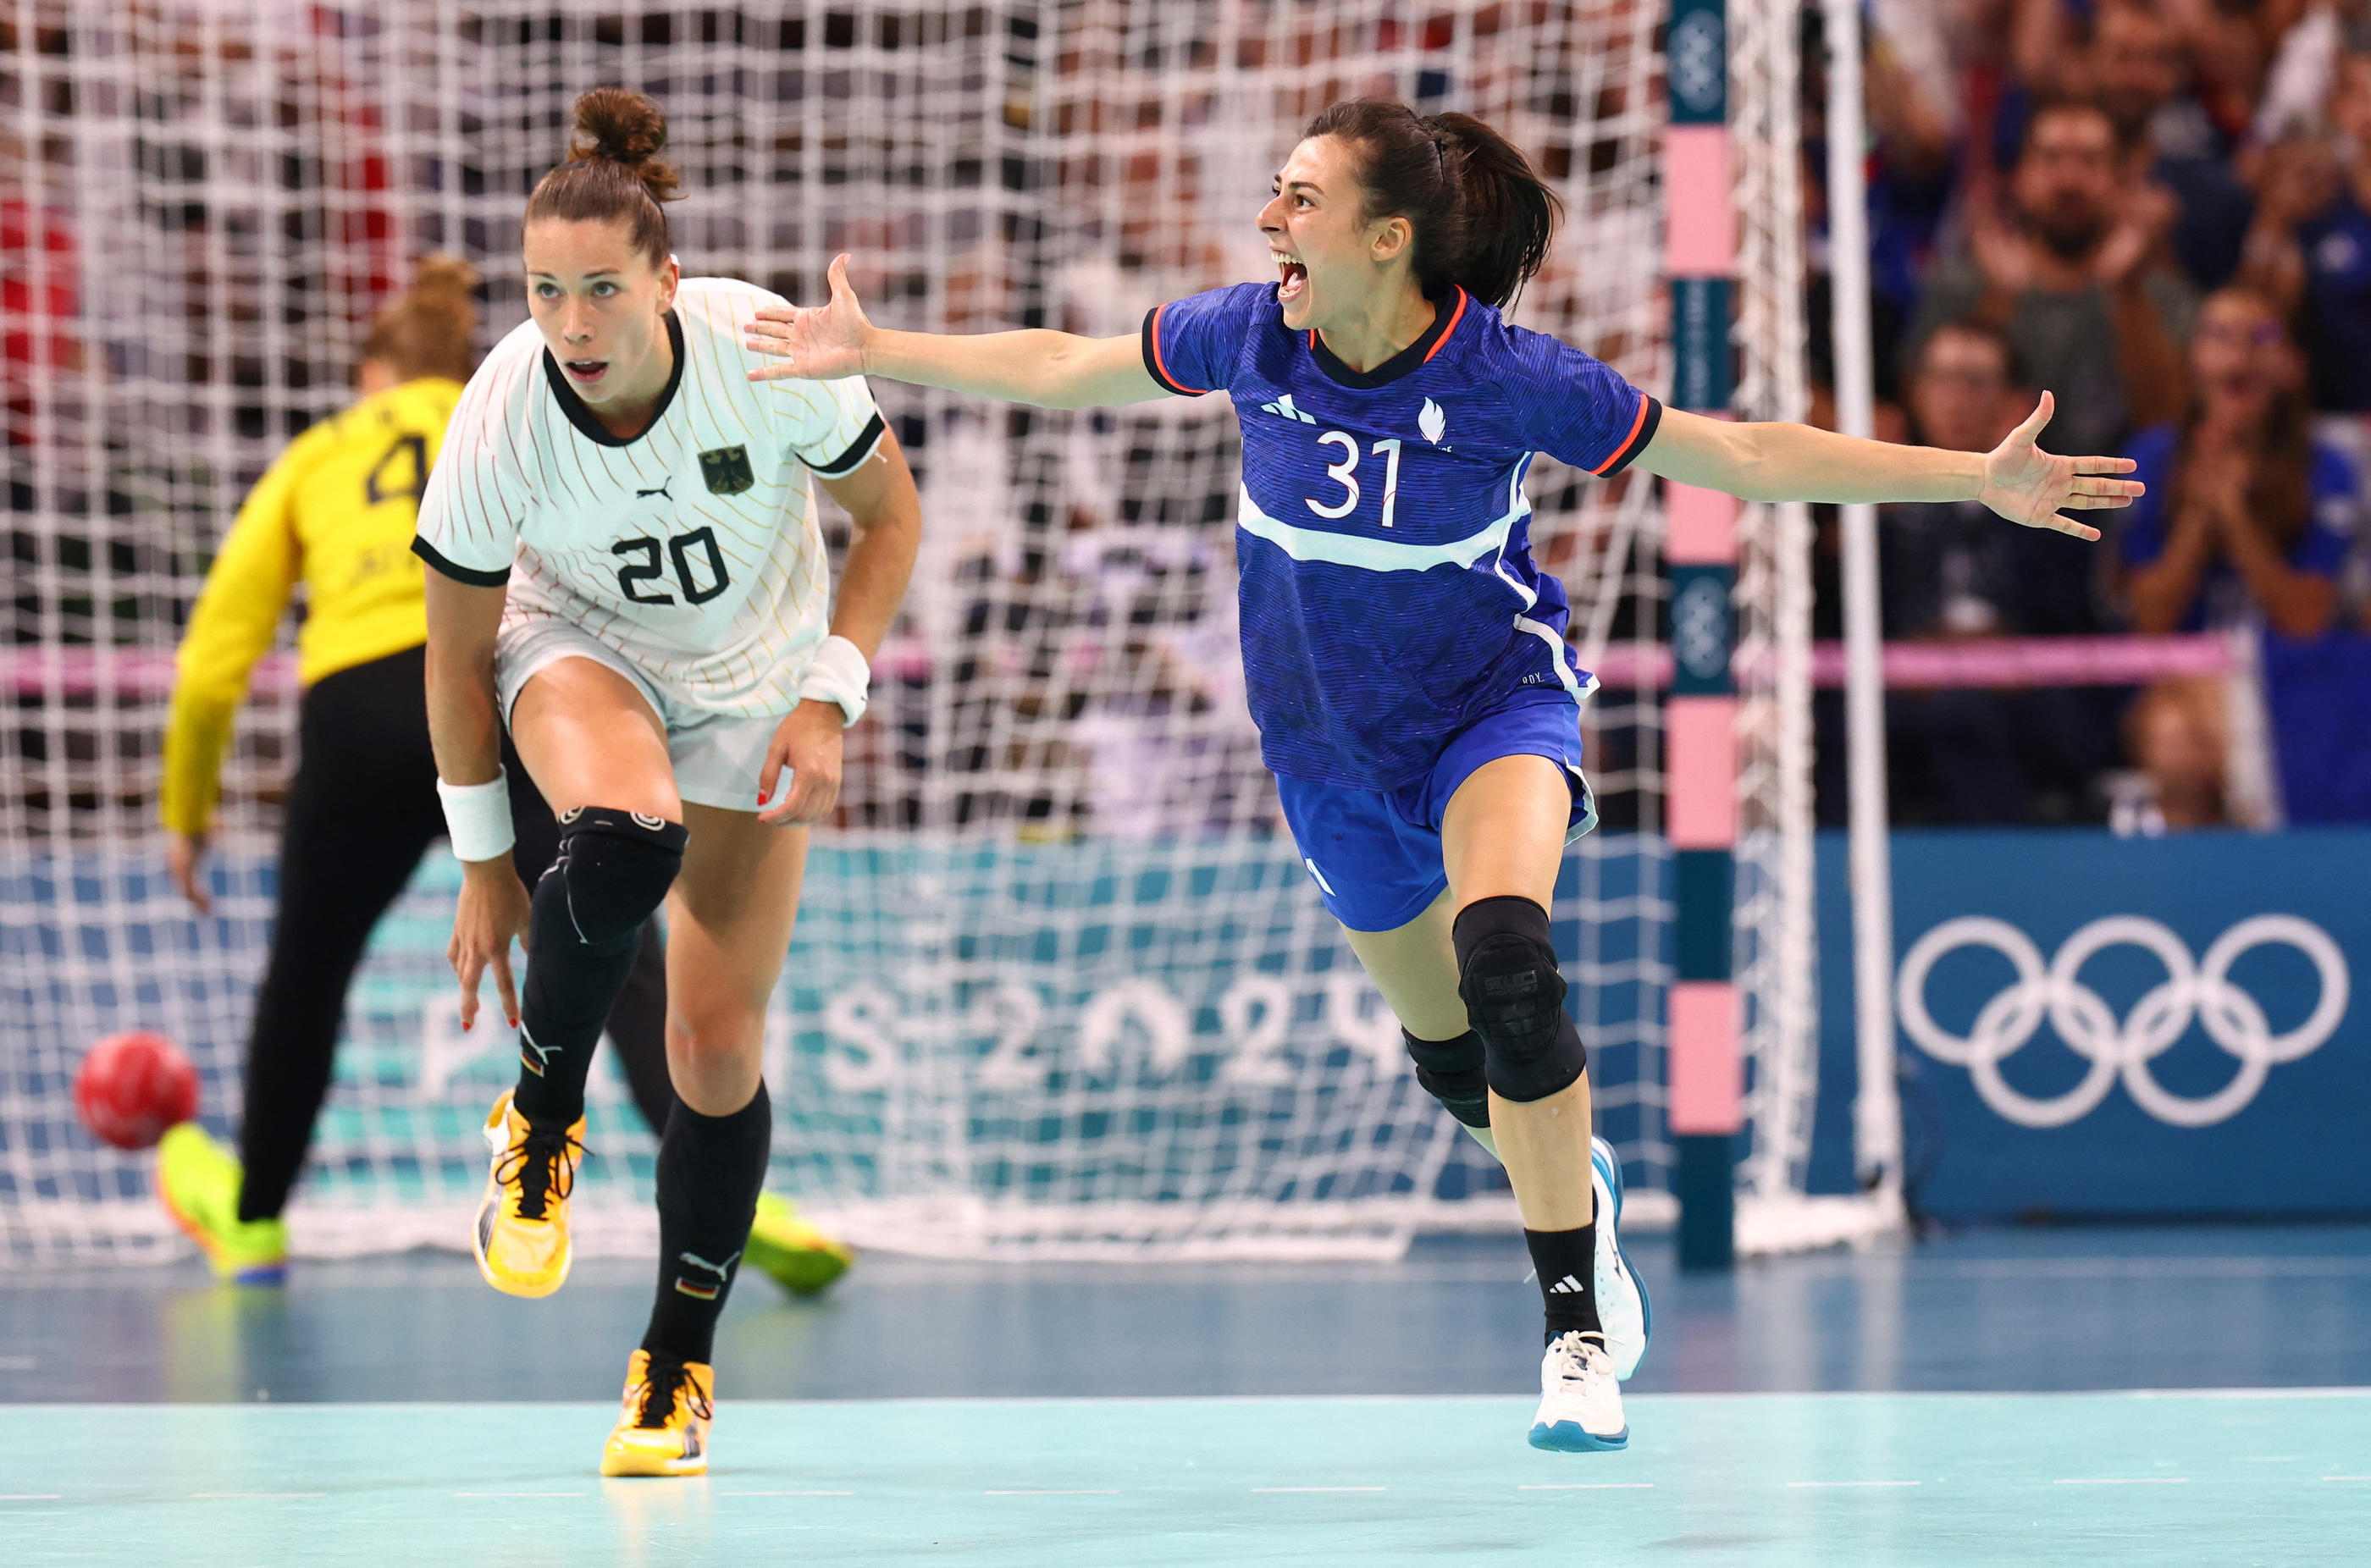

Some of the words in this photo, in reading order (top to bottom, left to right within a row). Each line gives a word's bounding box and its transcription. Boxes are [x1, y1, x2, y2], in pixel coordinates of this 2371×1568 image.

[1304, 430, 1401, 528] 31
[611, 526, 730, 606] 20
[423, 990, 896, 1097] PIS
[972, 973, 1406, 1087] 2024
